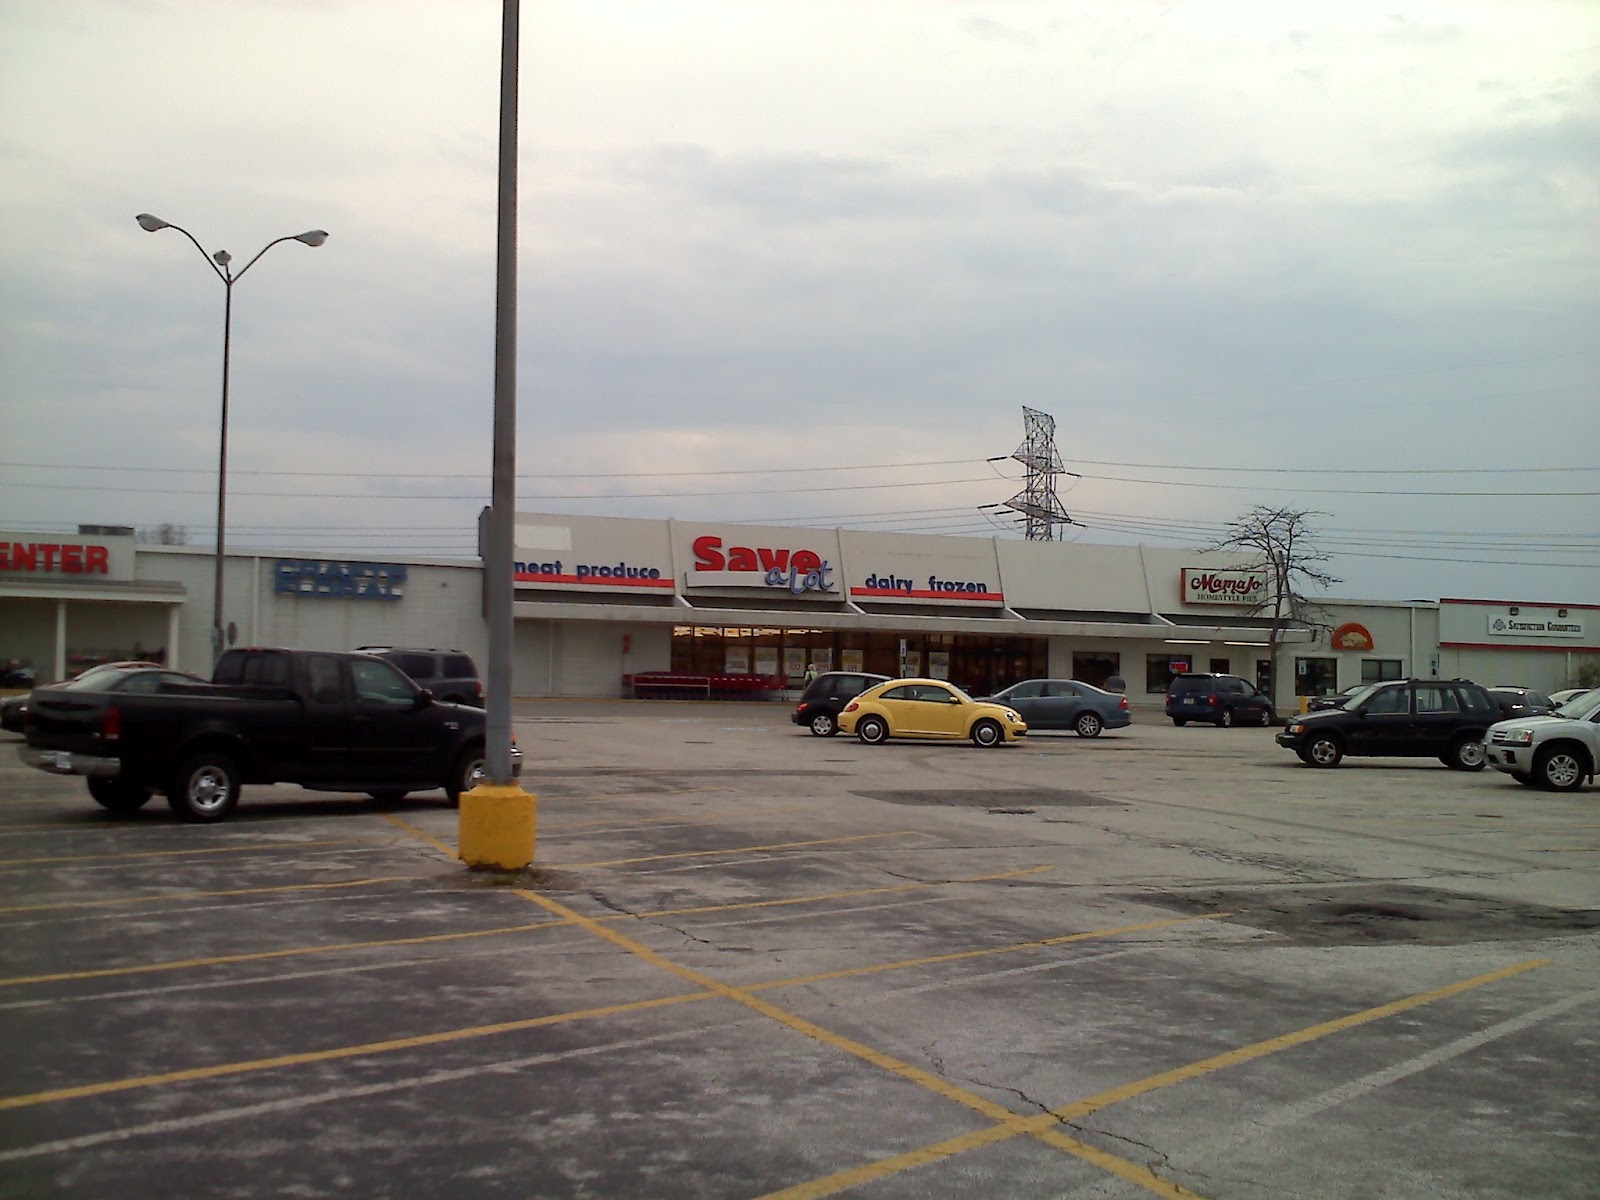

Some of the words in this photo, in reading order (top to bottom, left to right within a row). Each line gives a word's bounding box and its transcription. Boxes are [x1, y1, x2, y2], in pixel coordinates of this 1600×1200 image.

[692, 535, 822, 575] Save
[576, 562, 661, 582] produce
[865, 573, 913, 595] dairy
[928, 575, 988, 594] frozen
